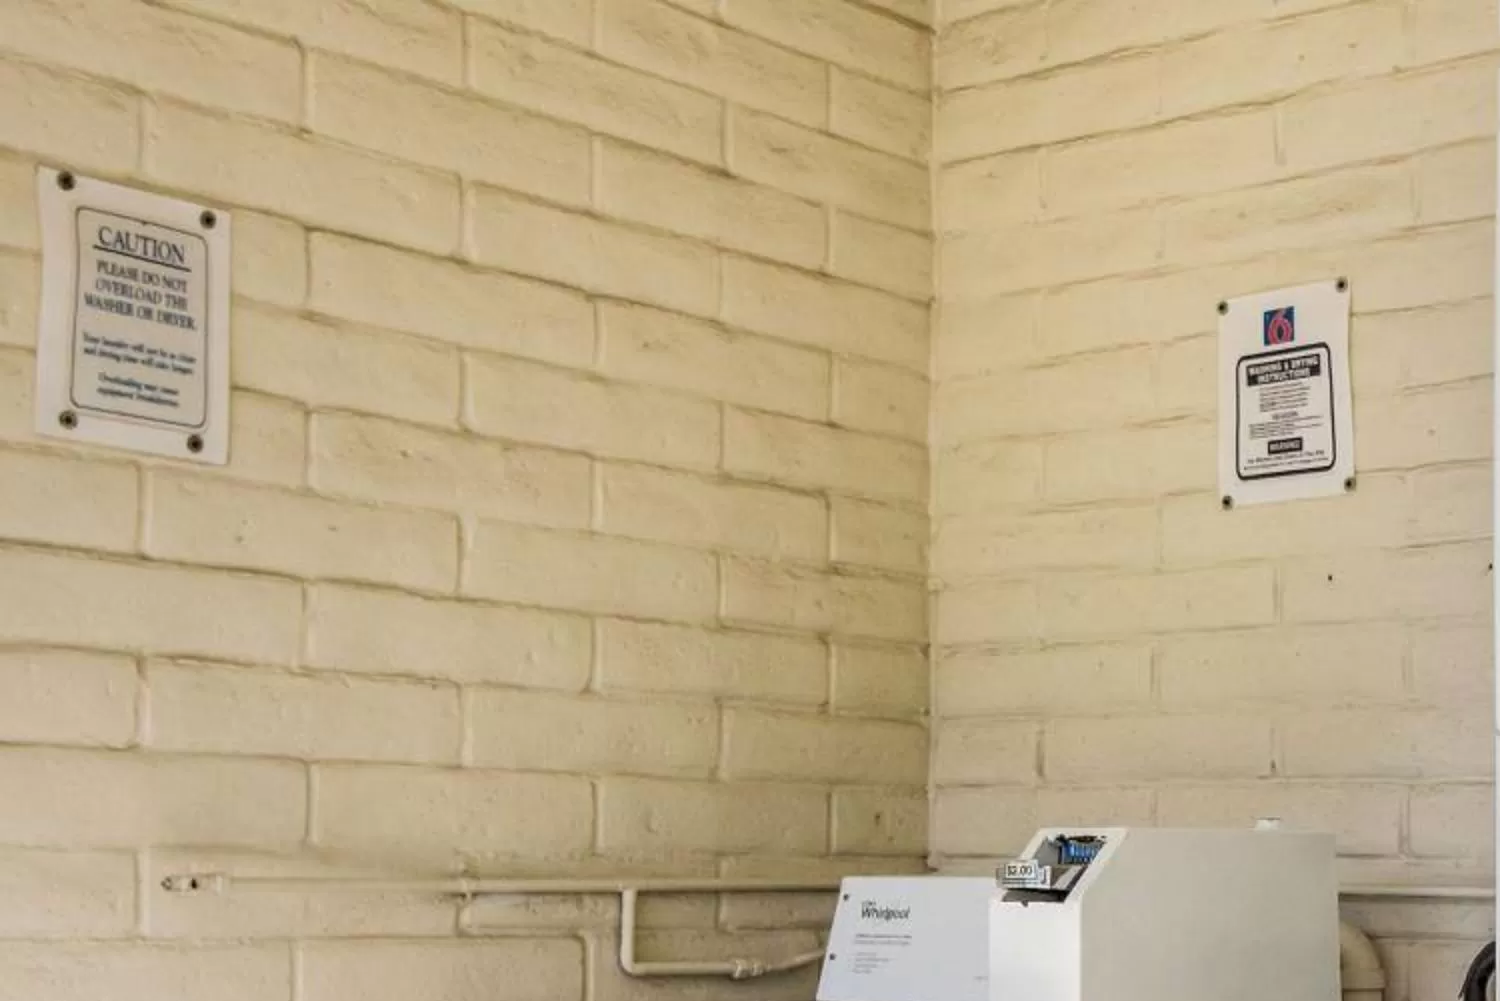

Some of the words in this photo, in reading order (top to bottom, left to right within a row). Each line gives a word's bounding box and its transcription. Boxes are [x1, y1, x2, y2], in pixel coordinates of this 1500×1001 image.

[98, 226, 185, 264] CAUTION
[96, 259, 138, 281] PLEASE
[142, 271, 160, 285] DO
[162, 275, 187, 293] NOT
[95, 279, 162, 304] OVERLOAD
[164, 293, 188, 310] THE
[861, 904, 911, 923] Whirlpool
